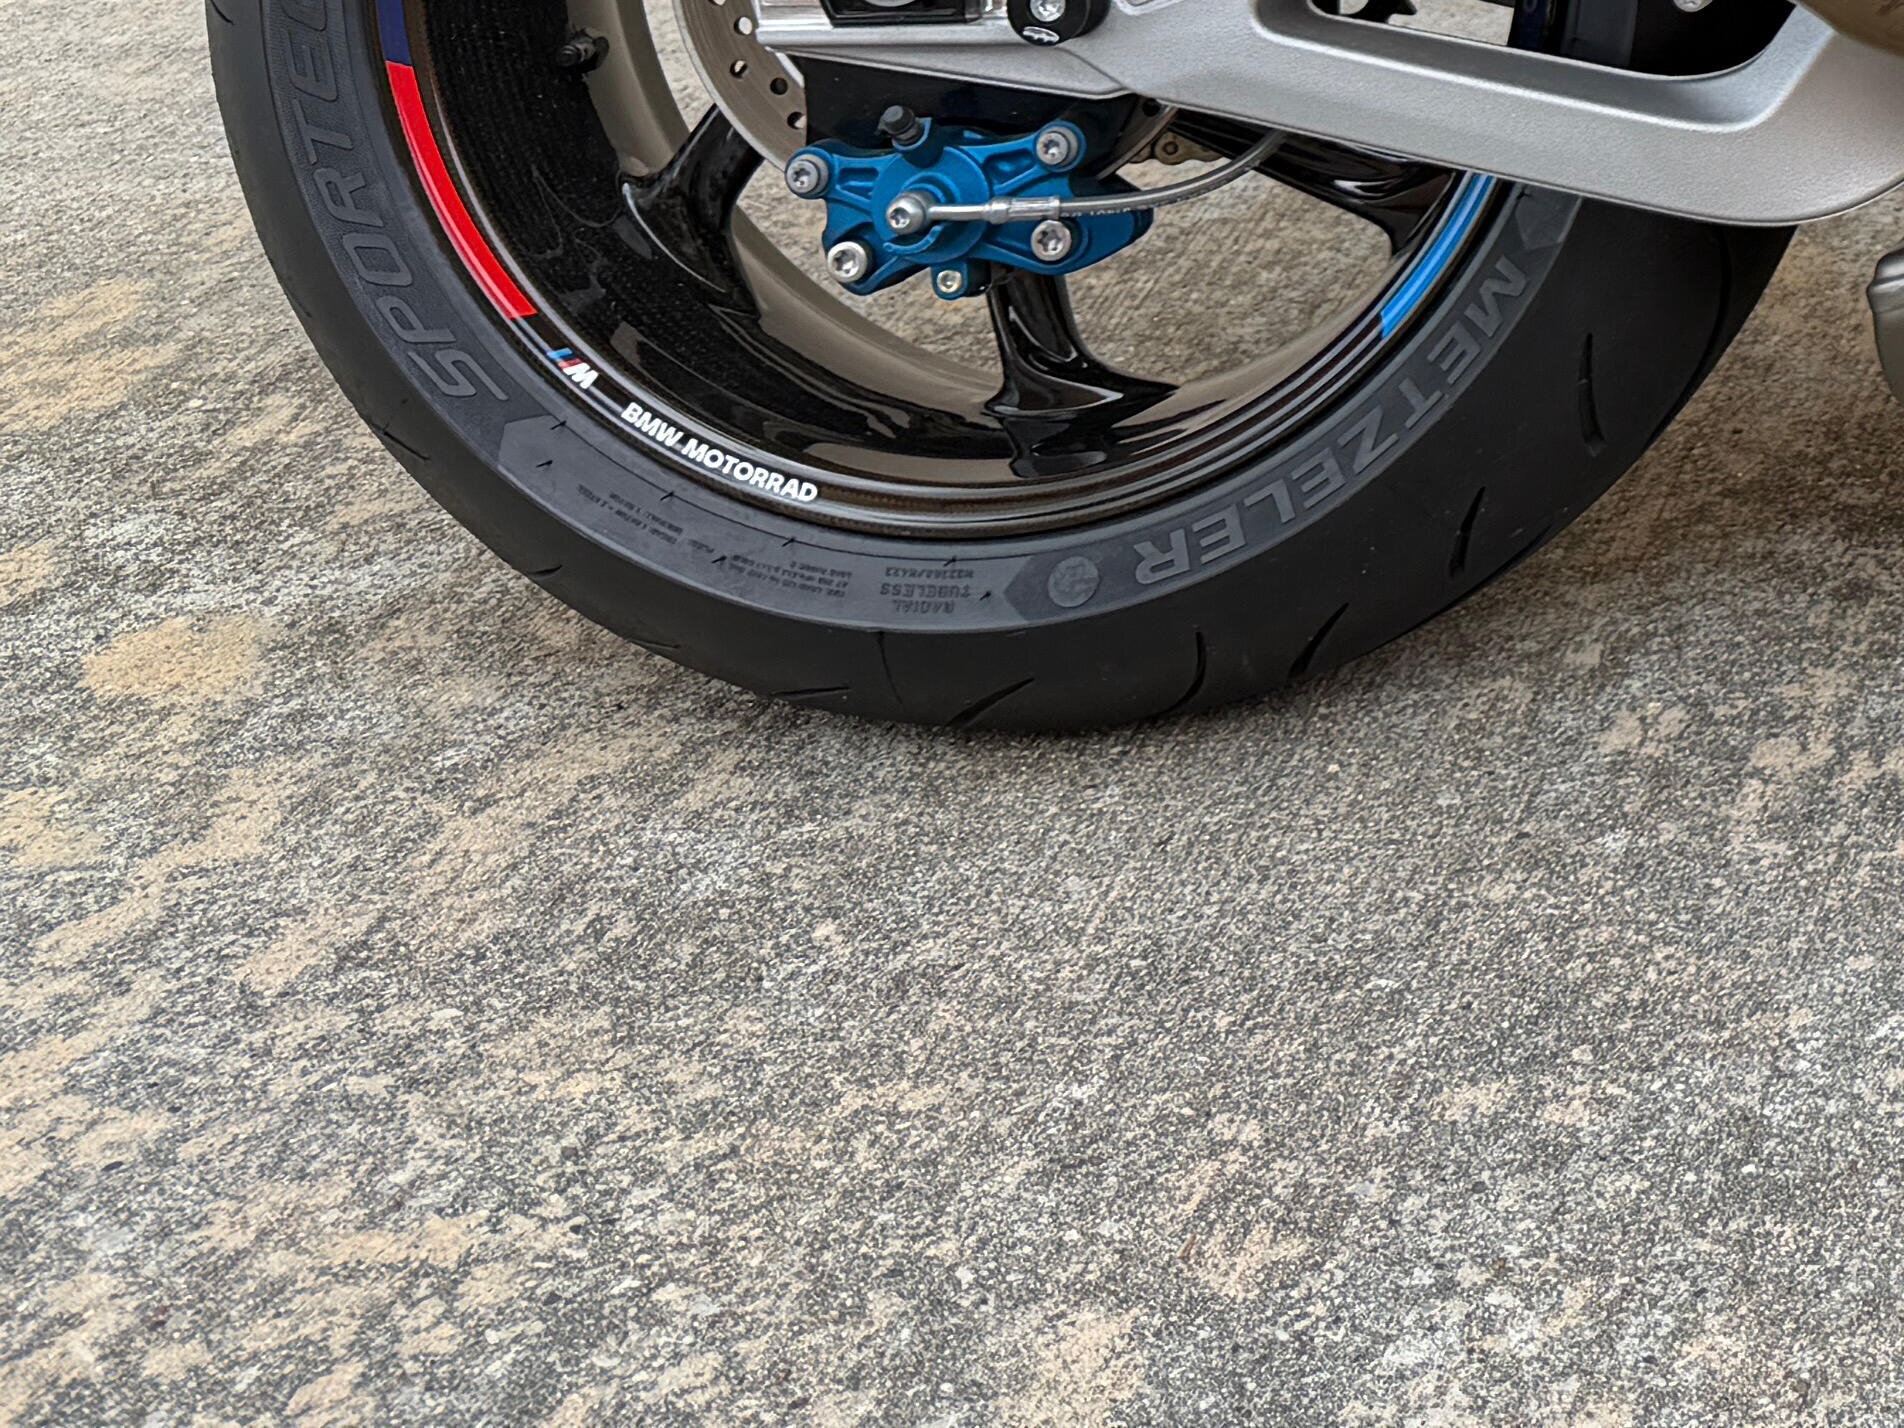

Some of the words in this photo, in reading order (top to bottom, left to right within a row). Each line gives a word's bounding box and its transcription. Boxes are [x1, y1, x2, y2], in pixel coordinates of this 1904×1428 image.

[620, 401, 684, 447] BMW
[681, 438, 819, 503] MOTORRAD
[1133, 254, 1529, 585] METZELER
